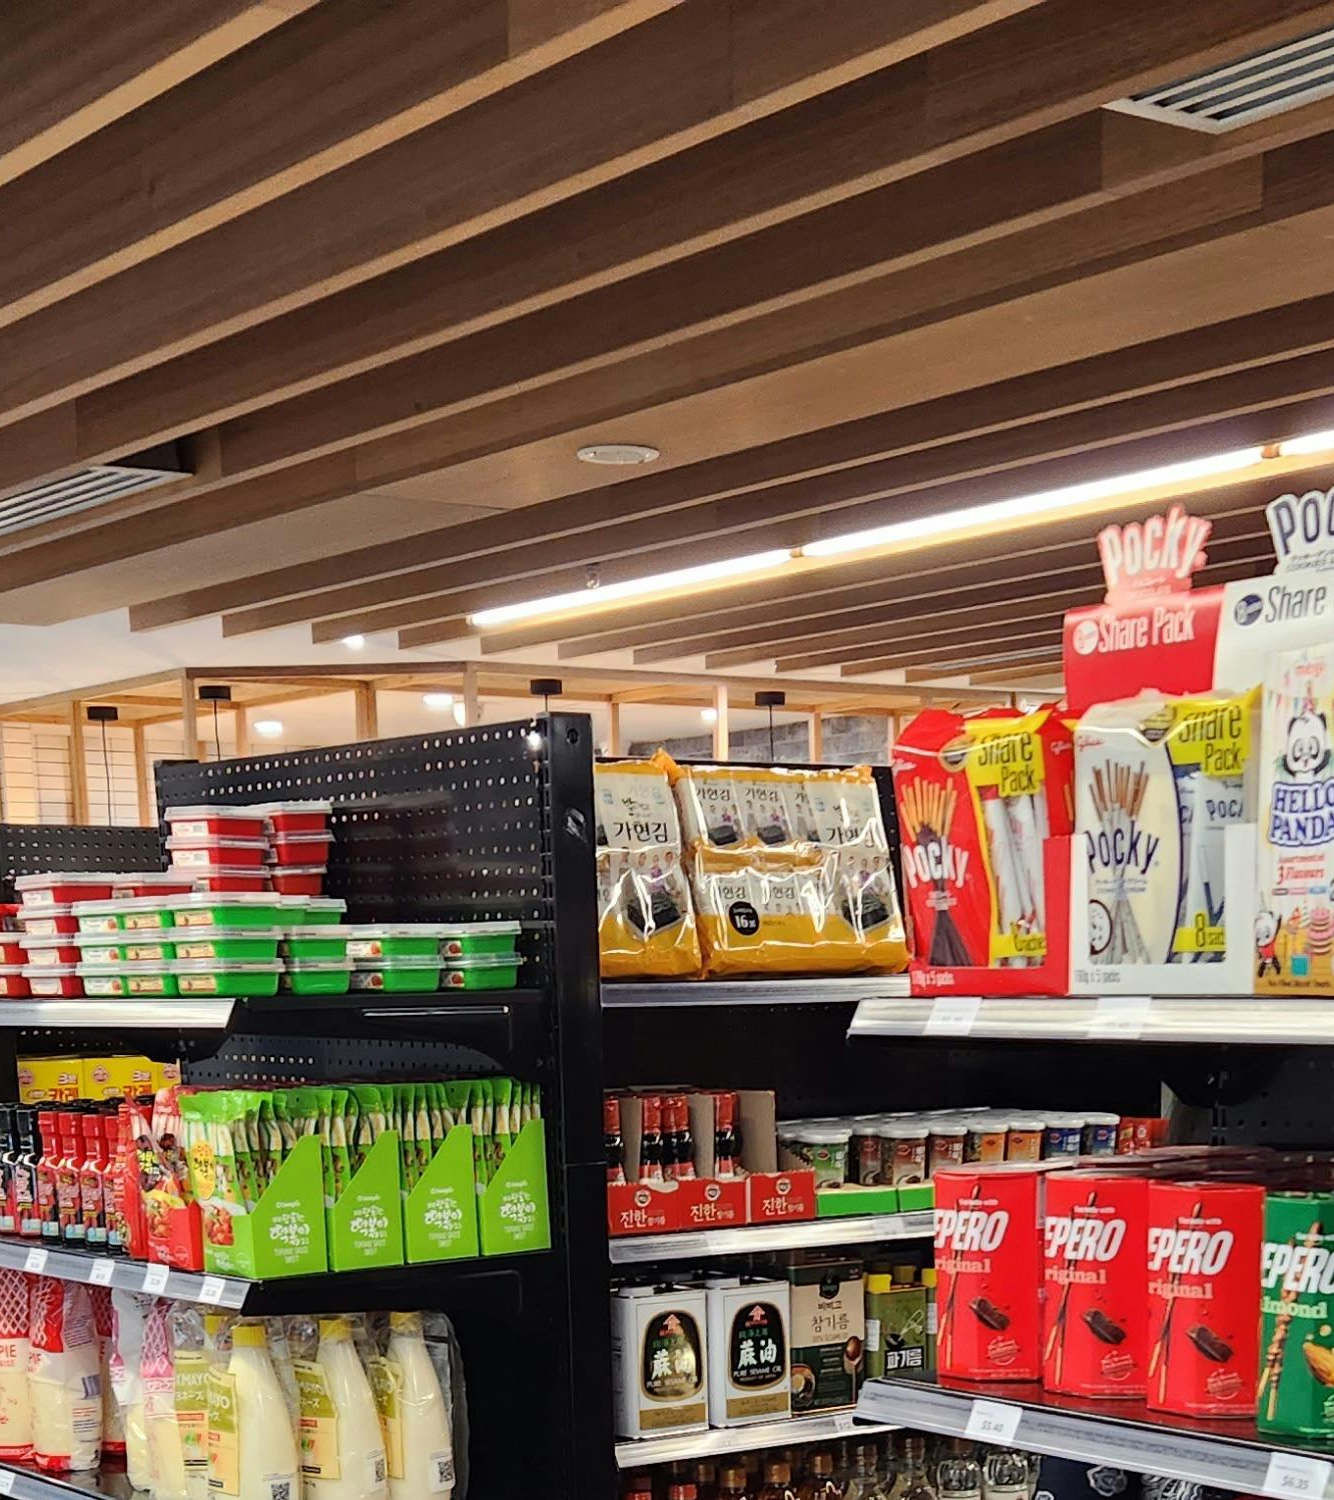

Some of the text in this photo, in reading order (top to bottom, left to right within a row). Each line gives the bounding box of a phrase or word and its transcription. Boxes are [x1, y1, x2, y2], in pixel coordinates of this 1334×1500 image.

[1265, 581, 1322, 624] Share
[1098, 604, 1194, 653] Share Pack
[1177, 705, 1242, 742] Share
[1204, 745, 1243, 773] Pack
[1000, 763, 1036, 794] Pack
[1277, 863, 1325, 884] 3 Flavours
[691, 1202, 717, 1223] 진한
[762, 1196, 788, 1216] 진한
[620, 1209, 648, 1229] 진한
[933, 1208, 1009, 1253] EPERO
[1043, 1215, 1128, 1263] EPERO
[1147, 1226, 1234, 1277] EPERO
[934, 1256, 992, 1274] riginal
[1044, 1267, 1107, 1285] riginal
[1148, 1279, 1213, 1300] riginal
[812, 1312, 850, 1333] 참기름
[886, 1348, 923, 1370] 파기름
